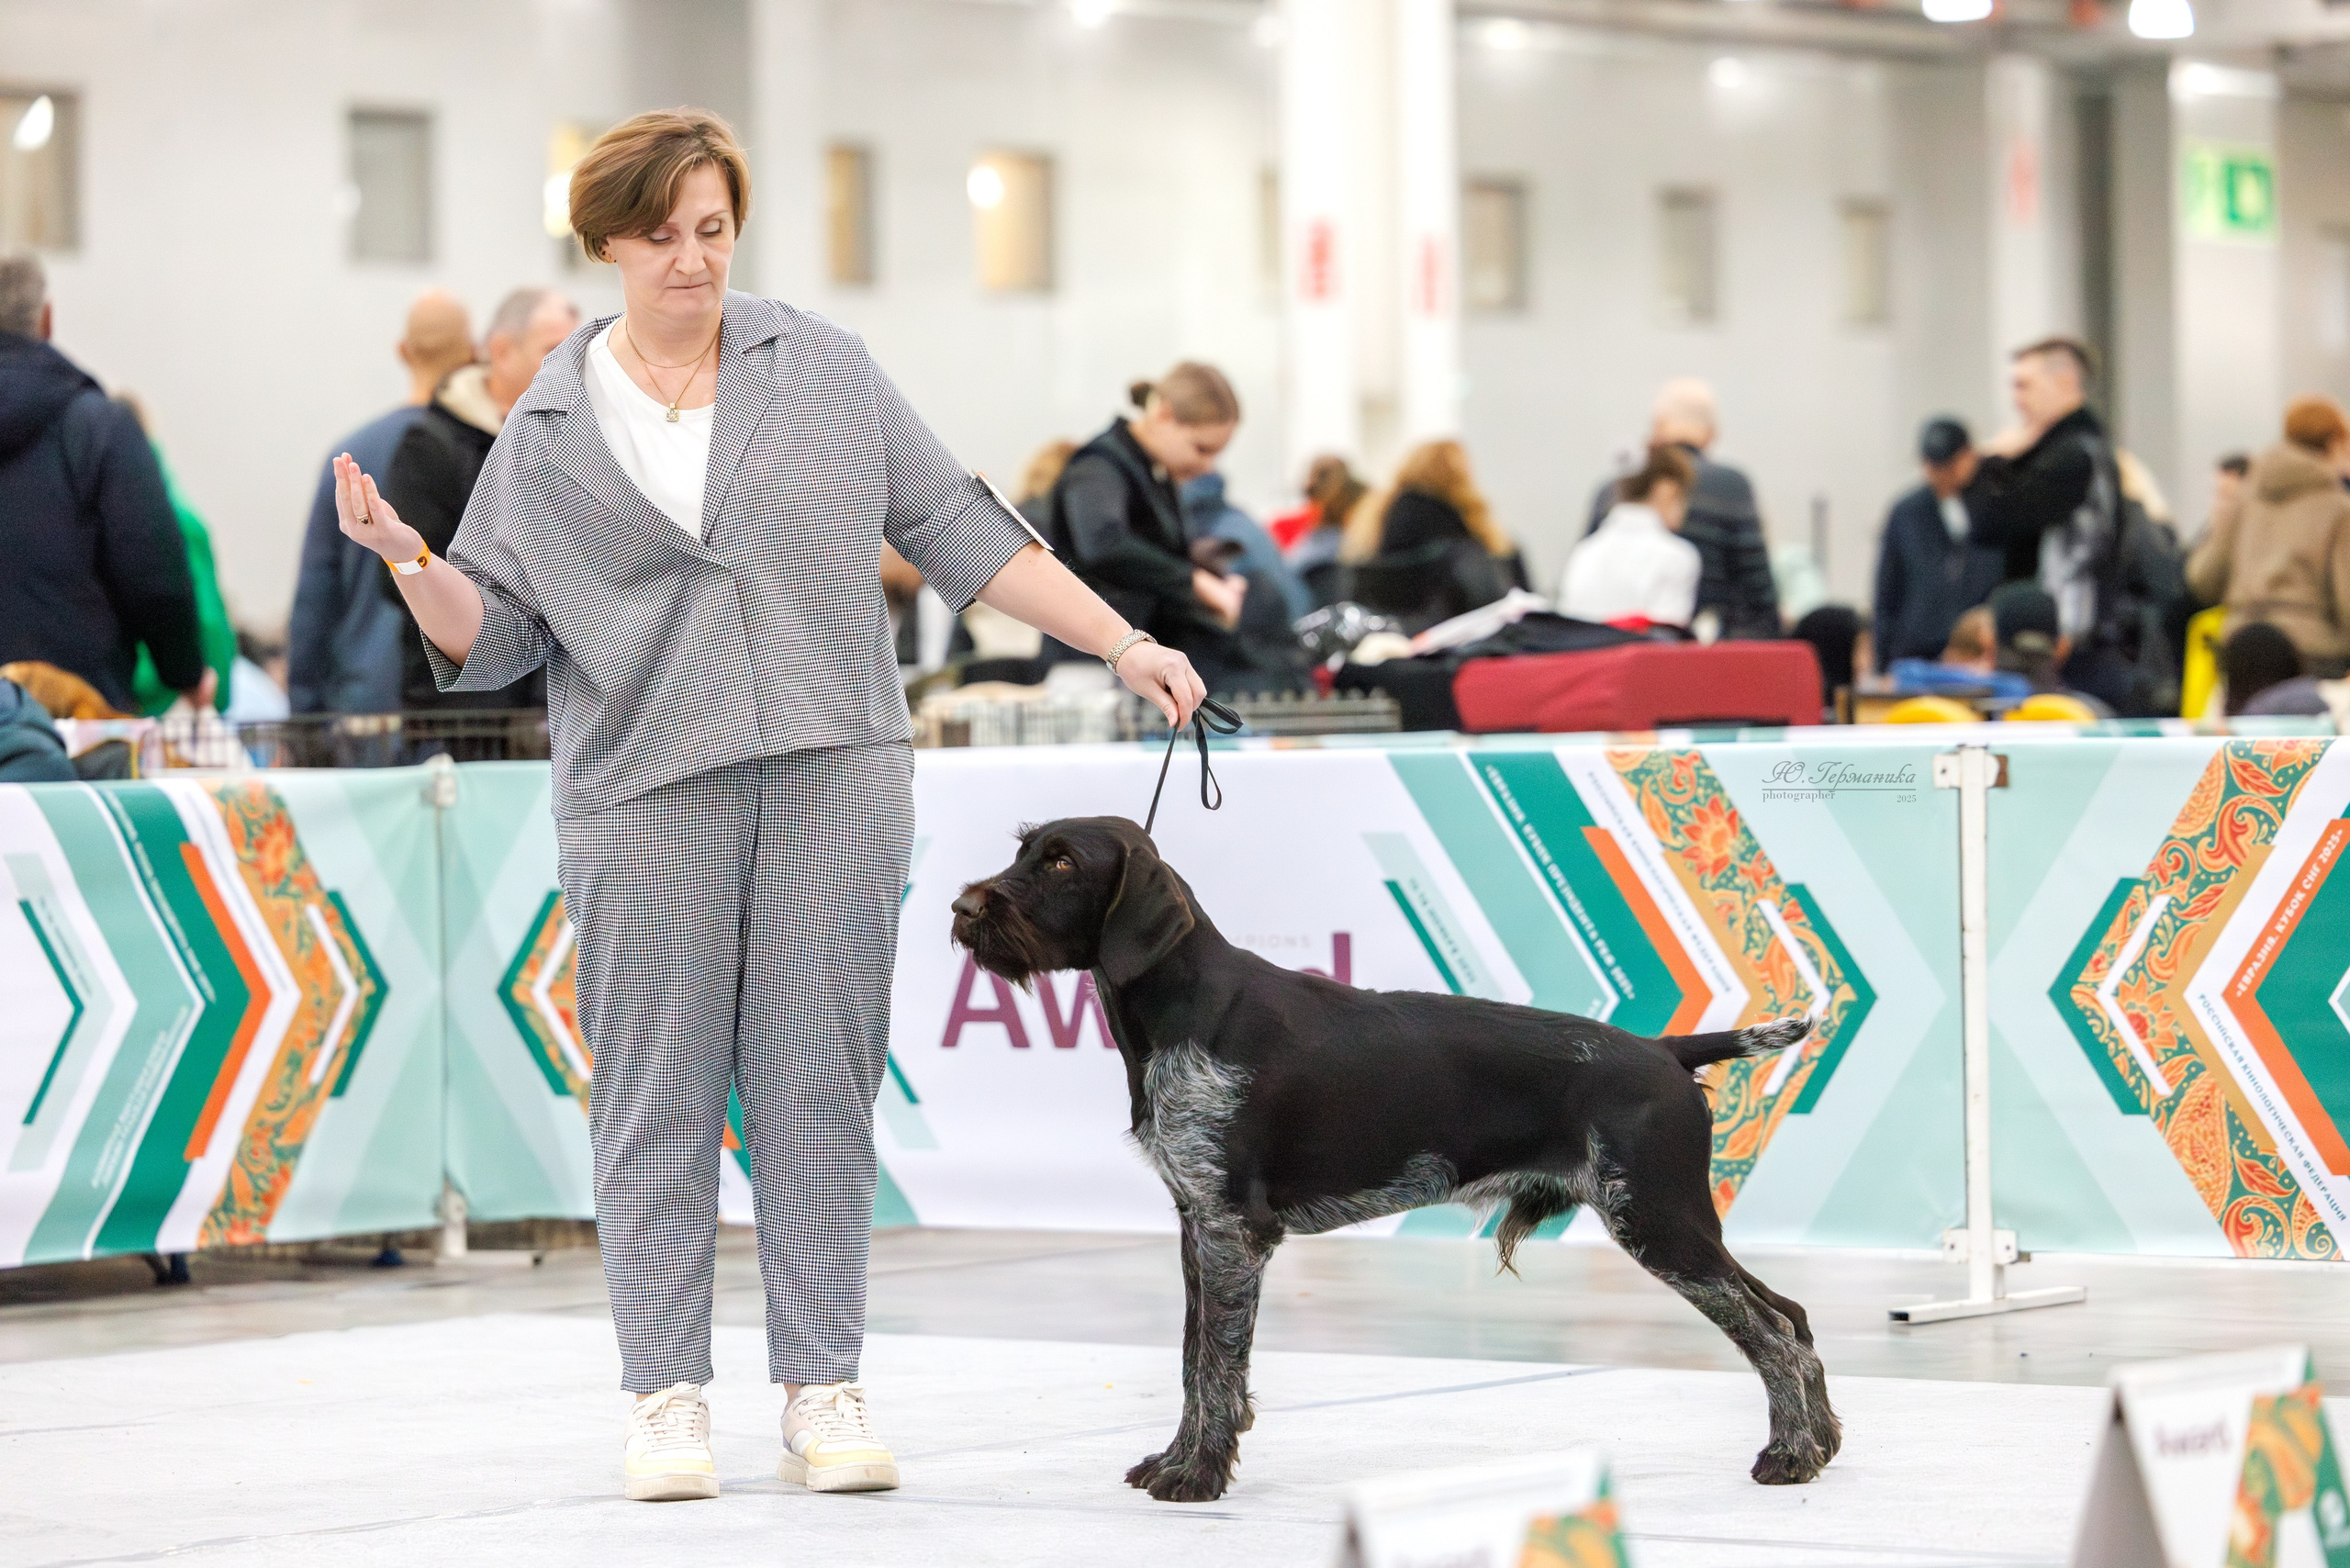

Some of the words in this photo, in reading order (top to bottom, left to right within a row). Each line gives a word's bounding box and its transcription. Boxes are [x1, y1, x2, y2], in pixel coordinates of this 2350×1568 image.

[2275, 890, 2307, 934] КУБОК
[2301, 862, 2322, 890] СНГ
[2198, 993, 2244, 1065] РОССИЙСКАЯ
[2241, 1062, 2305, 1159] КИНОЛОГИЧЕСКАЯ
[2301, 1158, 2347, 1222] ФЕДЕРАЦИЯ
